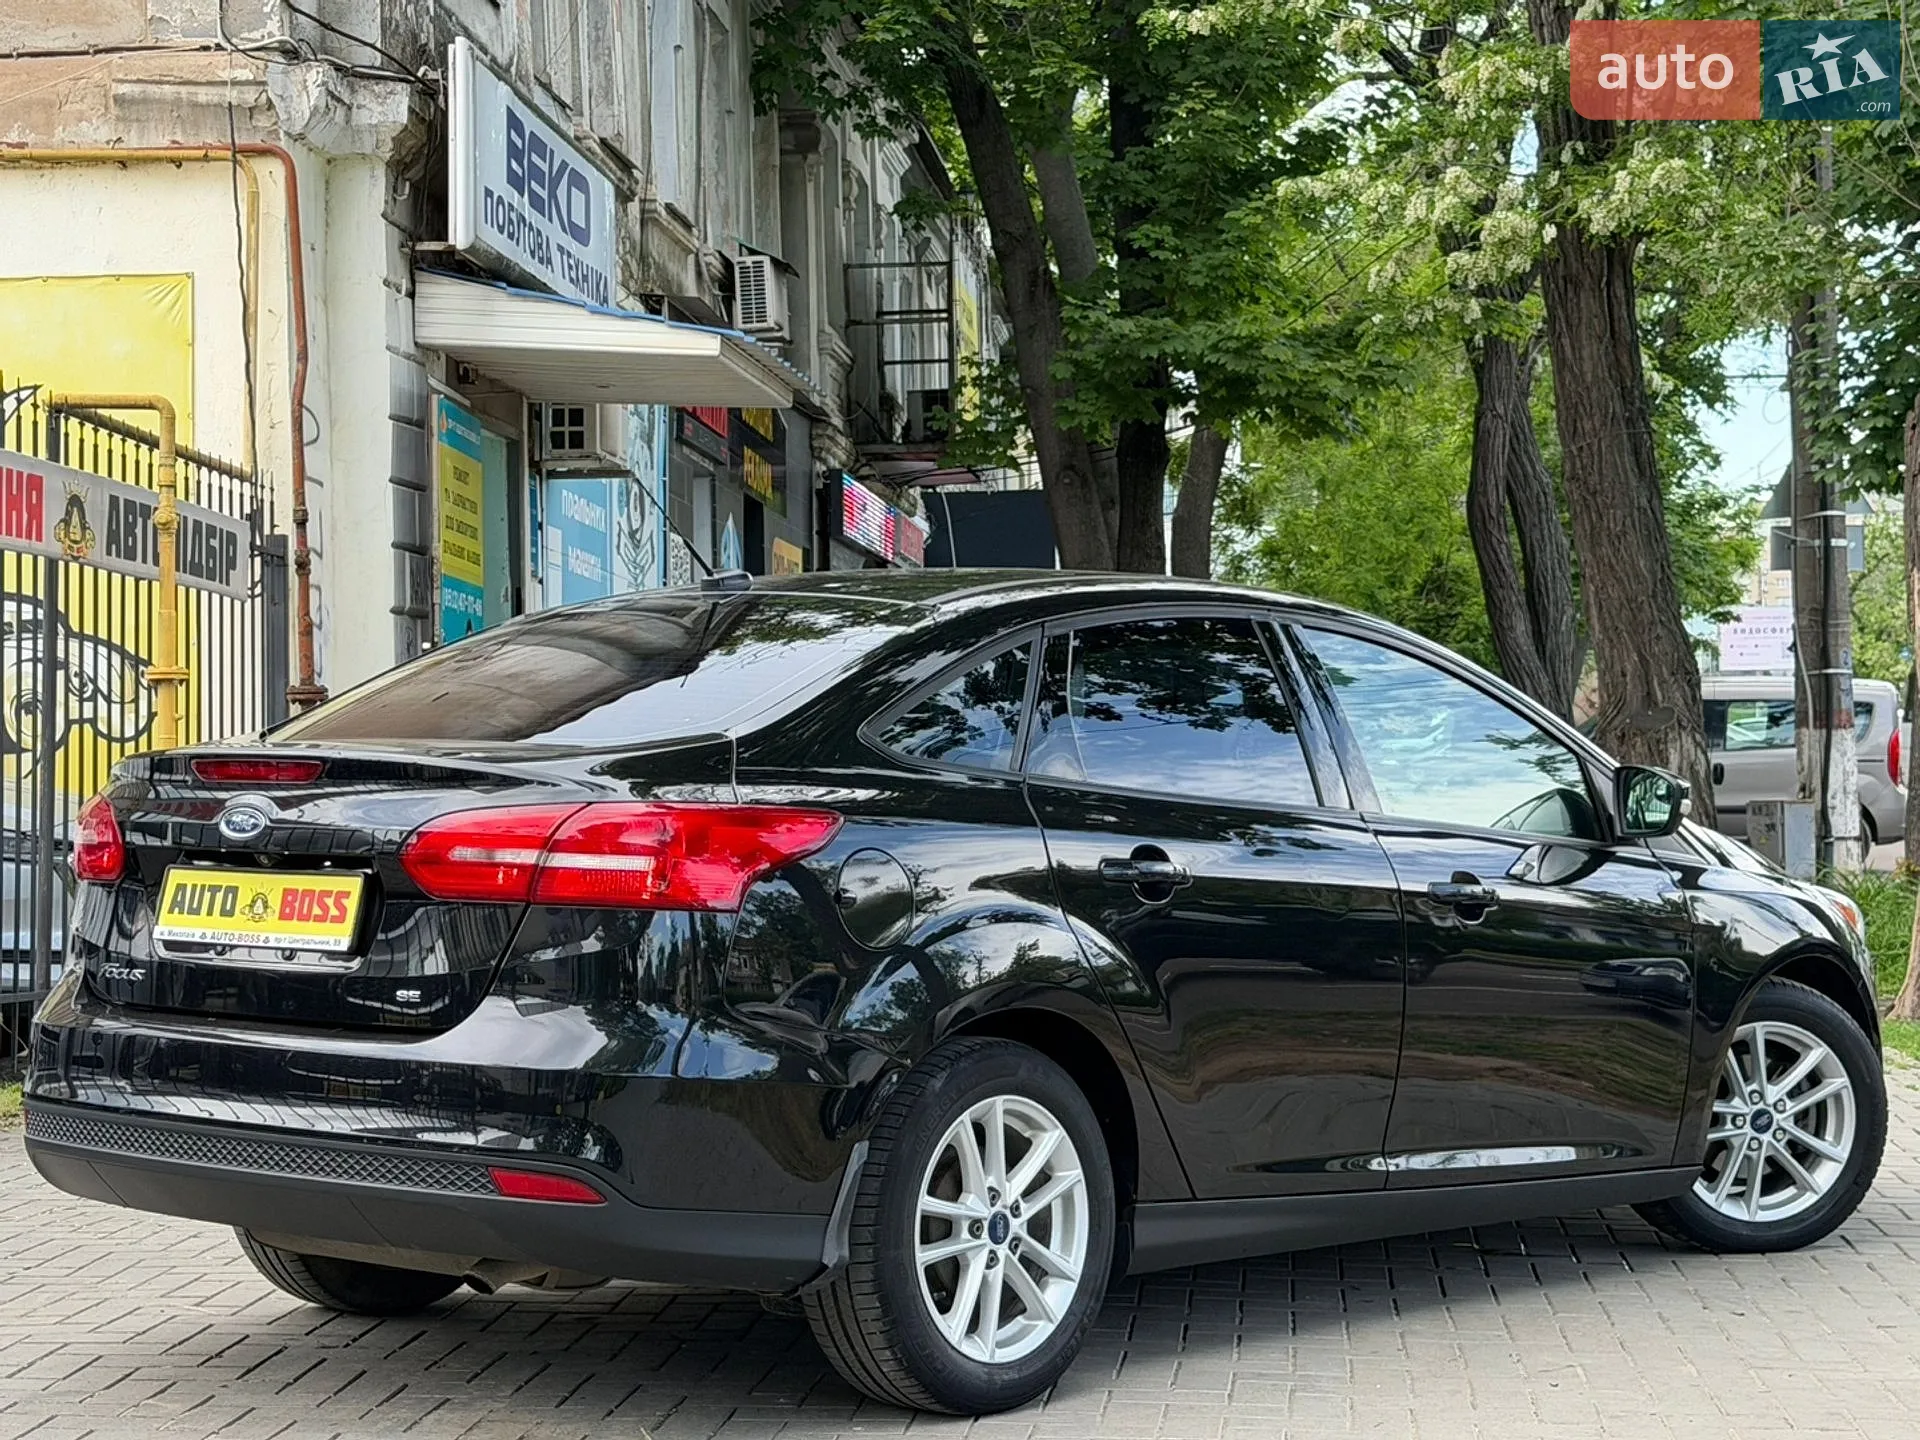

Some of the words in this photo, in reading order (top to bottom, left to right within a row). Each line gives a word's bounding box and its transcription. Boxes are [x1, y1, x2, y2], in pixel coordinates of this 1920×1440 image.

[506, 104, 591, 248] BEKO
[484, 185, 555, 273] ПОБУТОВА
[557, 243, 610, 308] ТЕХНІКА
[0, 466, 44, 543] НЯ
[167, 883, 240, 918] AUTO
[278, 887, 351, 924] BOSS
[210, 931, 262, 945] AUTO-BOSS
[395, 990, 421, 1002] SE
